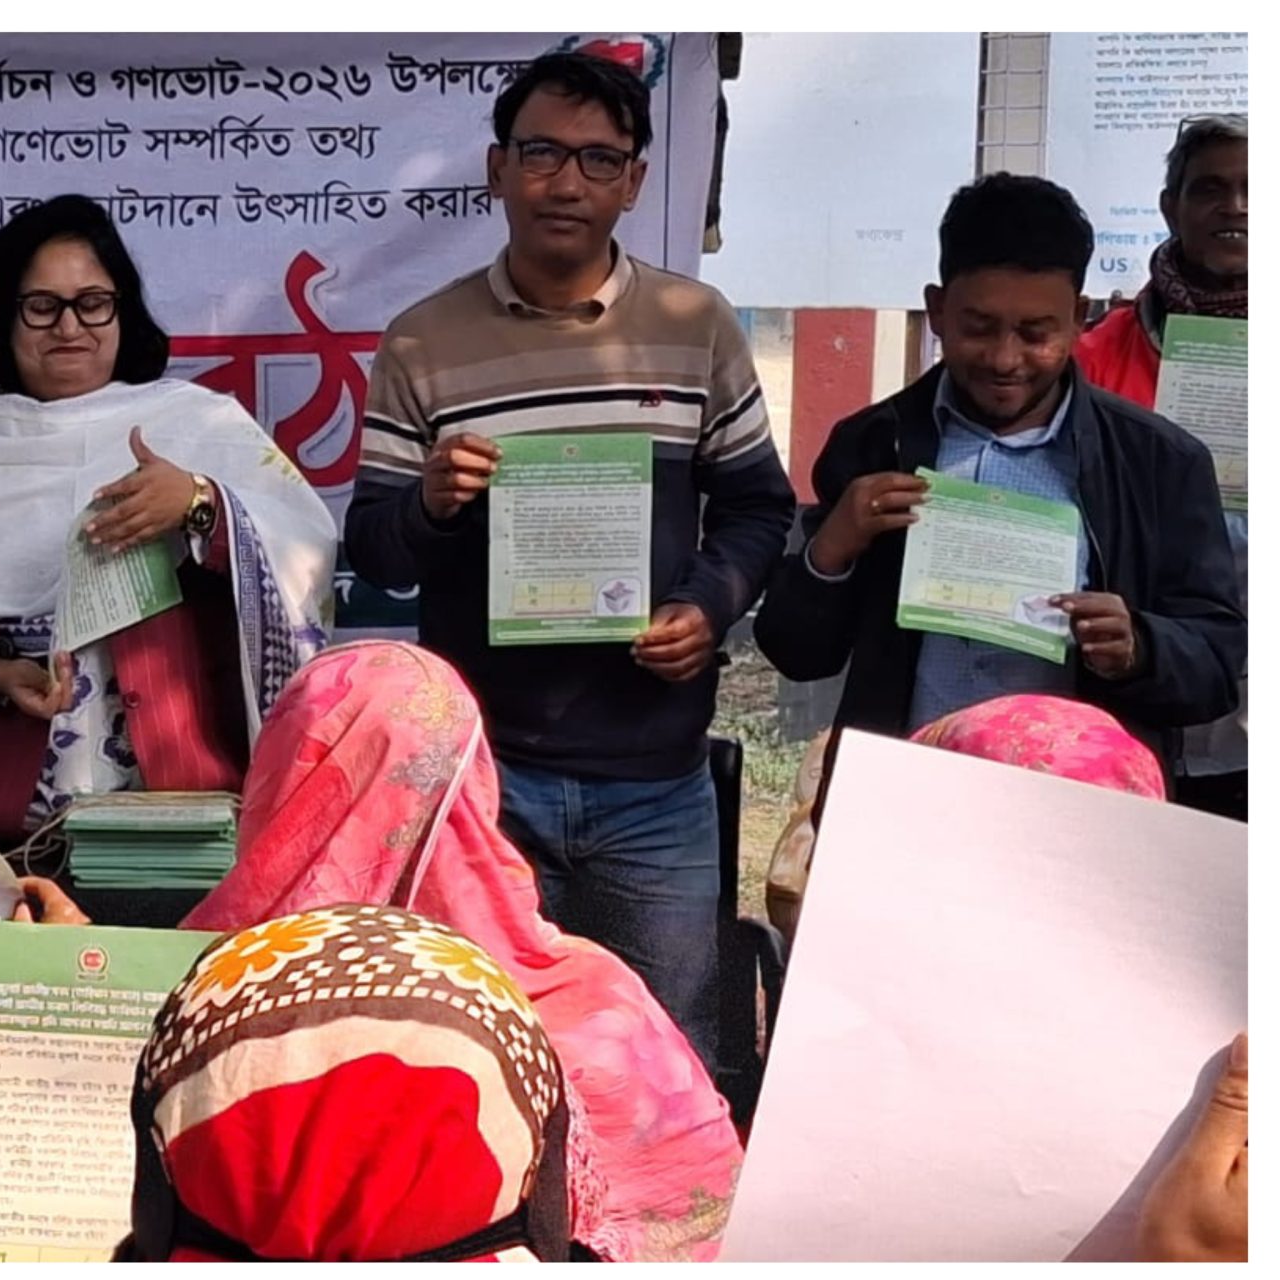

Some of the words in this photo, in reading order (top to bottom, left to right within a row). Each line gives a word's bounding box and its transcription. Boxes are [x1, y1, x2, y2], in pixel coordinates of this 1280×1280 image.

[68, 71, 96, 98] ও
[111, 57, 372, 103] গণভোট-২০২৬
[144, 114, 294, 161] সম্পর্কিত
[306, 122, 381, 161] তথ্য
[233, 180, 390, 224] উৎসাহিত
[401, 184, 491, 220] করার
